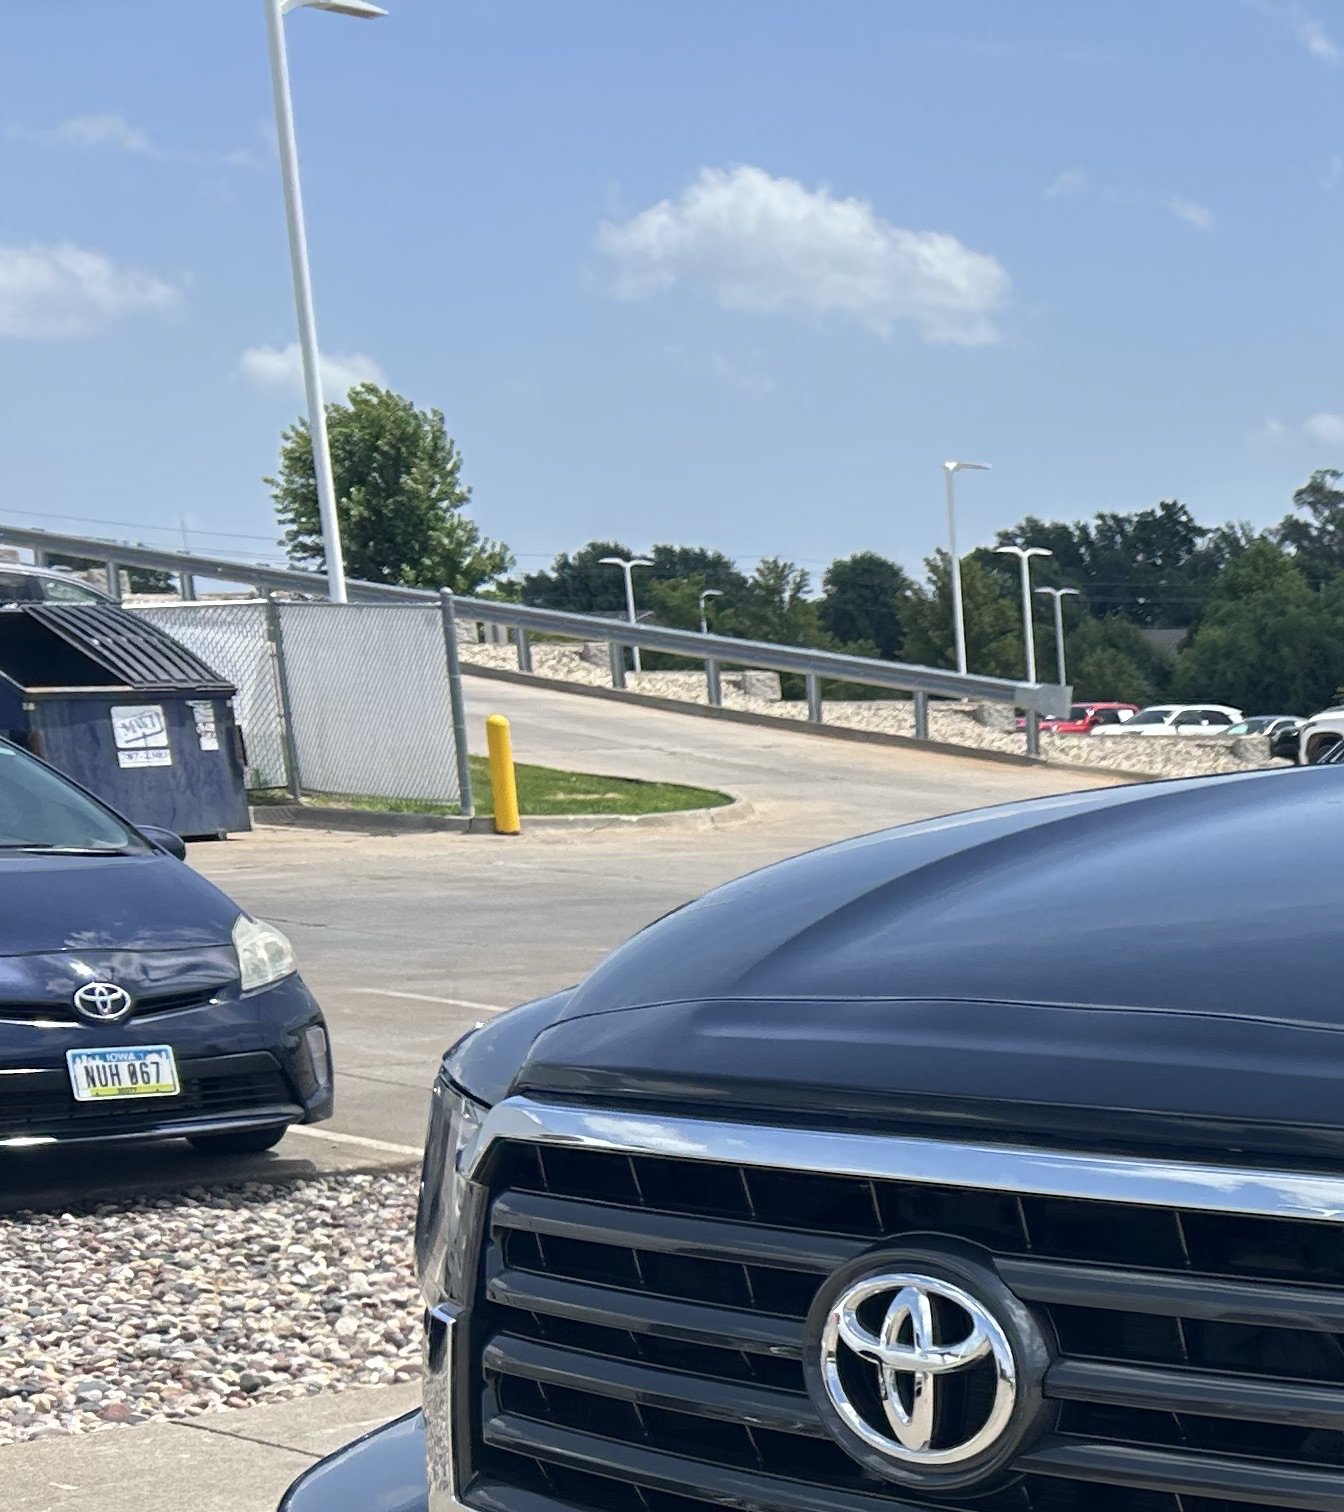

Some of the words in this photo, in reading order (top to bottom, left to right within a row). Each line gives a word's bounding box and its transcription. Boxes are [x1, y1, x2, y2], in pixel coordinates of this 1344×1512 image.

[105, 1052, 136, 1061] IOWA
[84, 1062, 121, 1089] NUH
[127, 1060, 160, 1086] 067
